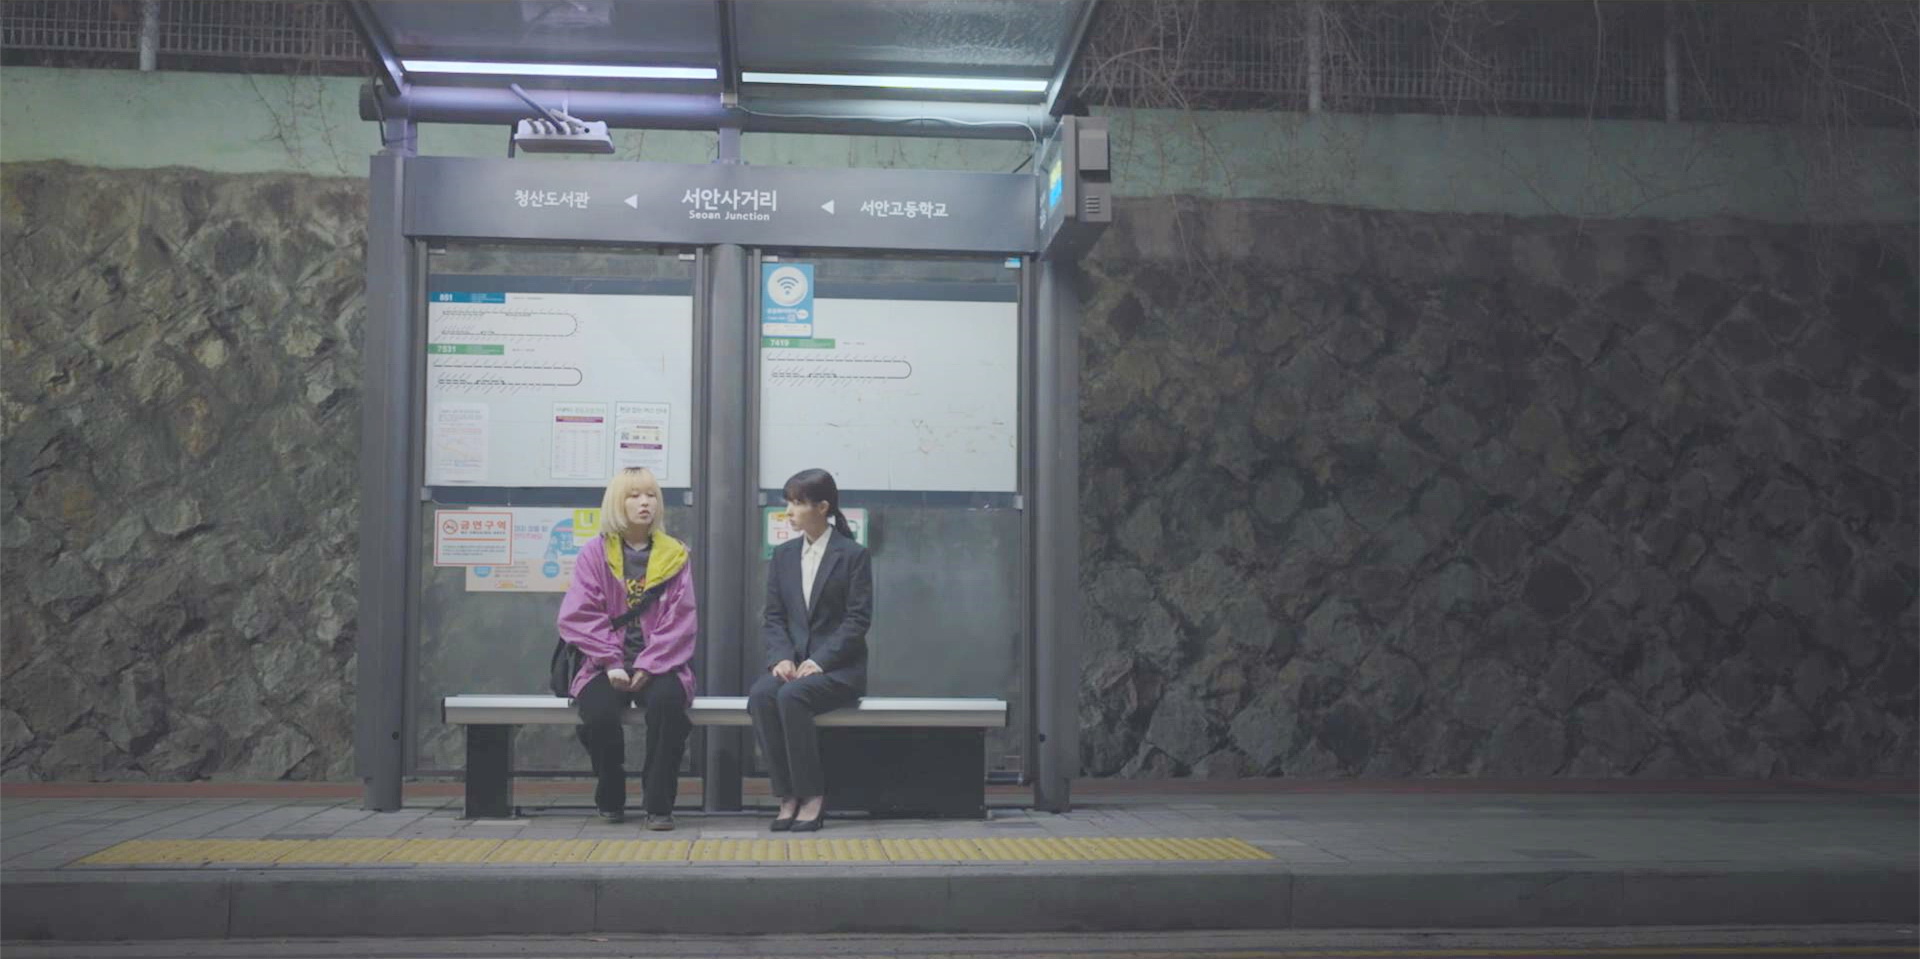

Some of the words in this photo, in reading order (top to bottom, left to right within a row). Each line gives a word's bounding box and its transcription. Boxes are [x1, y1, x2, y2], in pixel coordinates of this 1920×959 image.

[514, 189, 590, 209] 청산도서관
[681, 188, 777, 212] 서안사거리
[860, 199, 949, 219] 서안고등학교
[689, 210, 721, 220] Seoan
[724, 211, 770, 221] Junction
[460, 520, 507, 531] 금연구역
